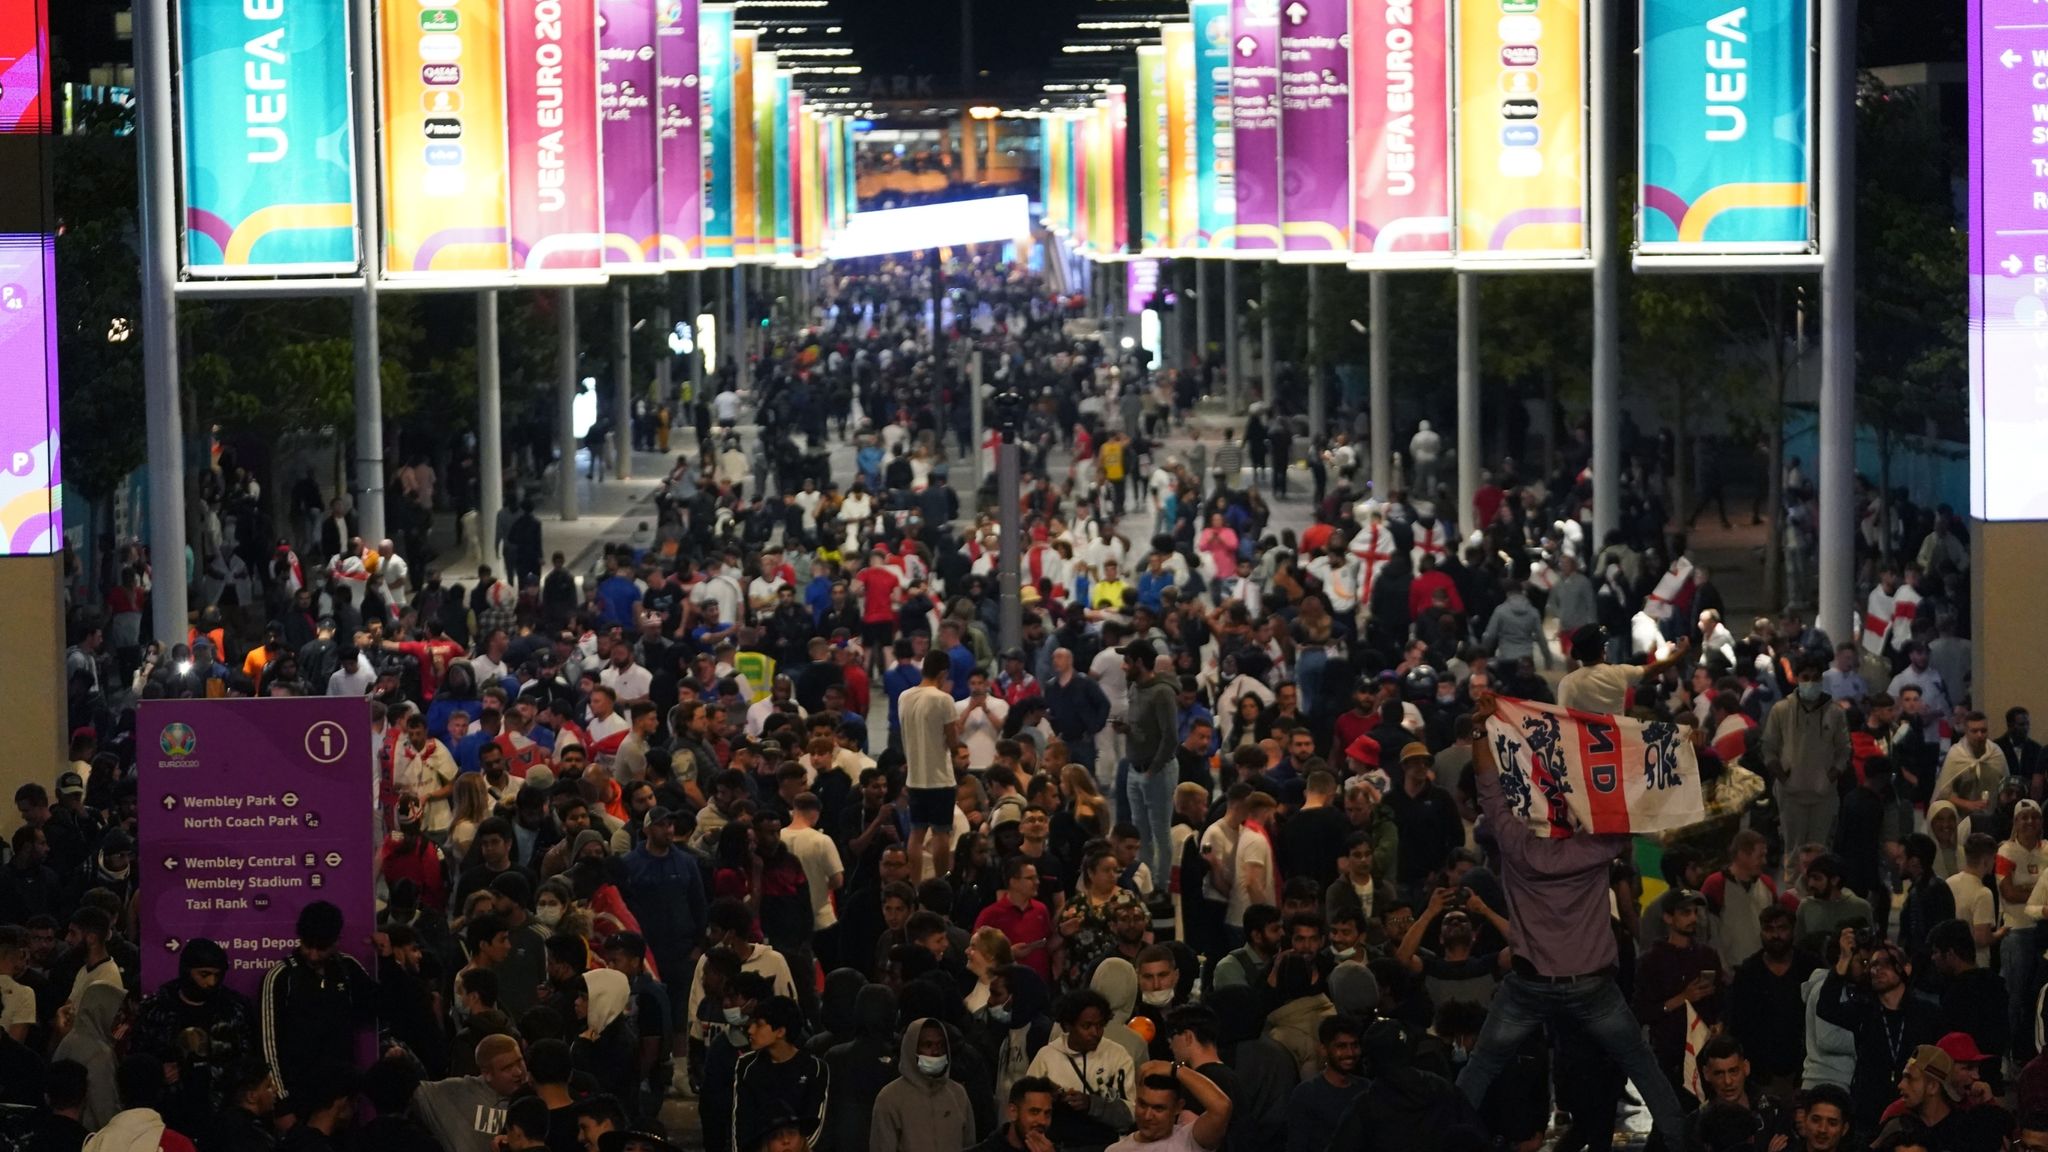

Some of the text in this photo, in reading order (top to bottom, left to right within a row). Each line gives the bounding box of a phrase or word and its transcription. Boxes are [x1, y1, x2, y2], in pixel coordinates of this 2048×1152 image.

[1281, 36, 1336, 50] Wembley
[1282, 50, 1311, 61] Park
[1282, 71, 1319, 83] North
[1385, 28, 1413, 112] EURO
[1705, 6, 1748, 142] UEFA
[243, 0, 288, 163] UEFA E
[1283, 83, 1348, 95] Coach Park
[535, 0, 566, 212] UEFA EURO 20
[1308, 96, 1332, 108] Left
[1386, 114, 1415, 196] UEFA
[184, 795, 277, 809] Wembley Park
[184, 816, 222, 828] North
[226, 816, 265, 827] Coach
[268, 814, 298, 826] Park
[185, 855, 297, 870] Wembley Central
[185, 876, 302, 891] Wembley Stadium
[186, 898, 212, 910] Taxi
[215, 898, 248, 909] Rank
[233, 938, 258, 951] Bag
[262, 937, 301, 950] Depos
